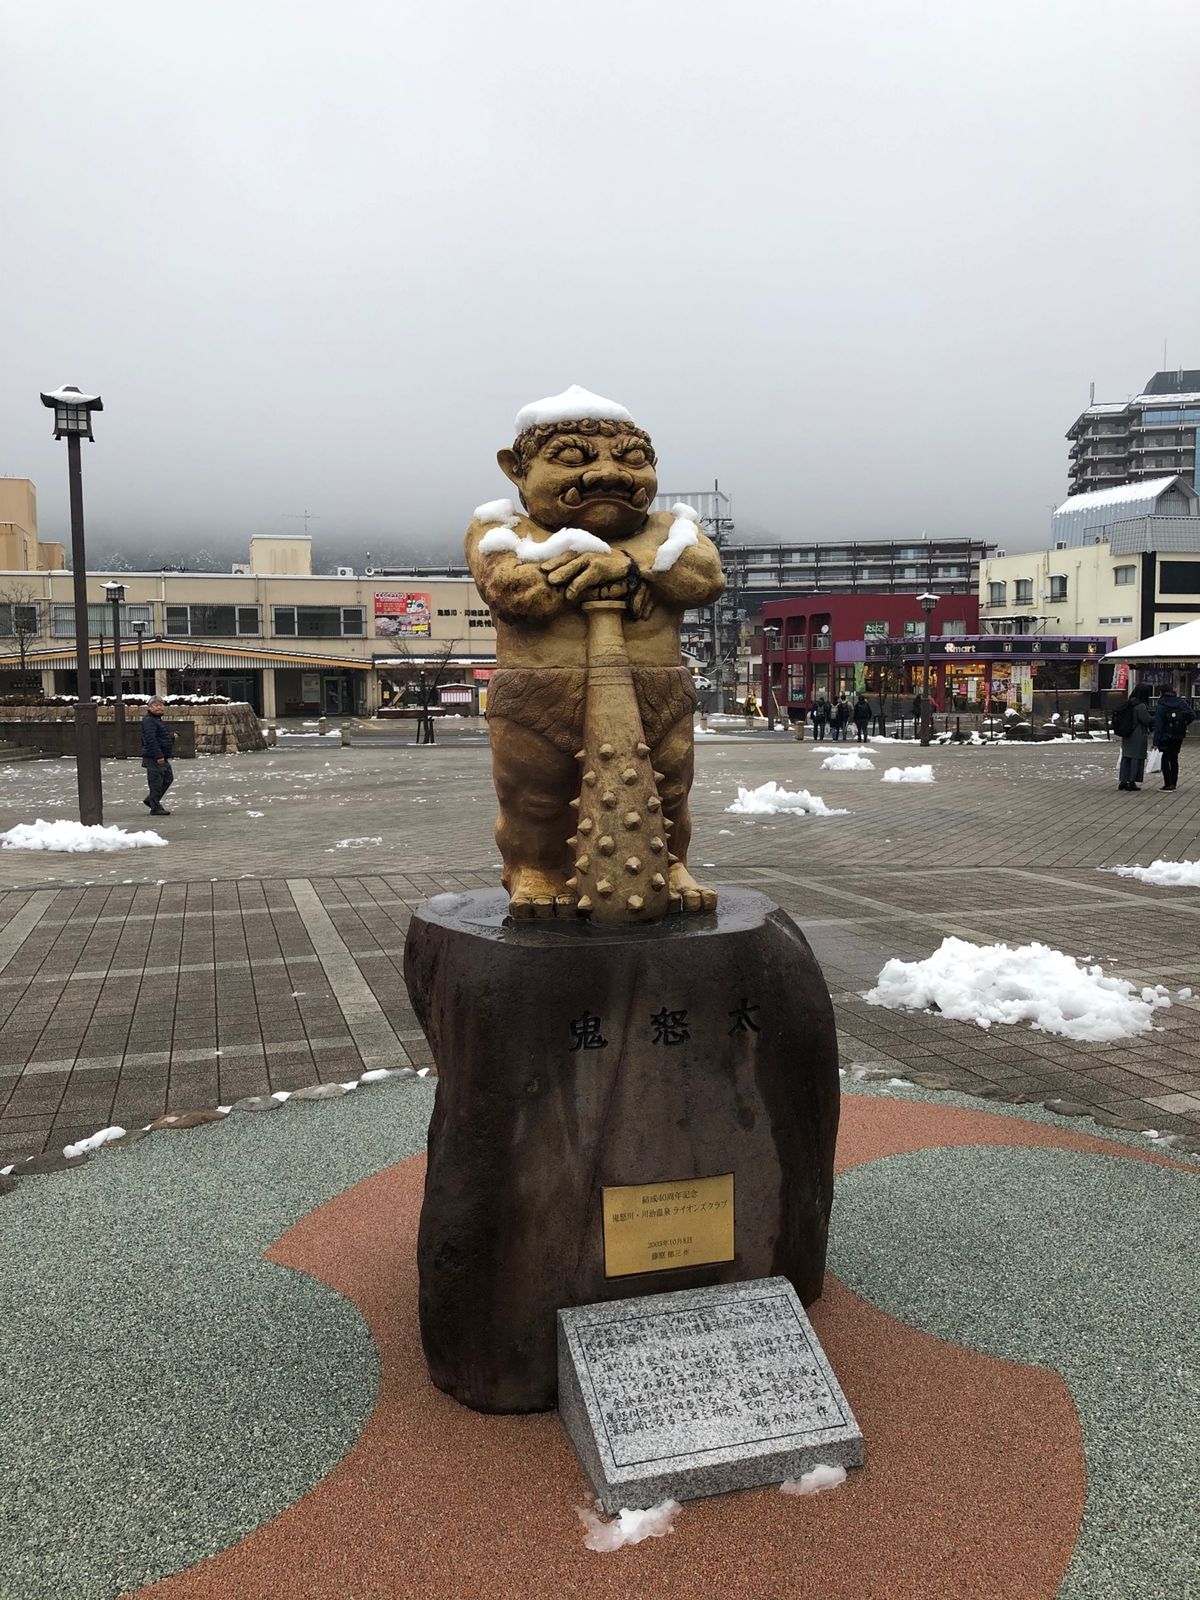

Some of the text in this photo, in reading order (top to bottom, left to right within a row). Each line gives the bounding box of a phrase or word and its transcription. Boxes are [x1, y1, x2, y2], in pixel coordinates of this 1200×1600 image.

[642, 1190, 698, 1204] 結成40周年記念
